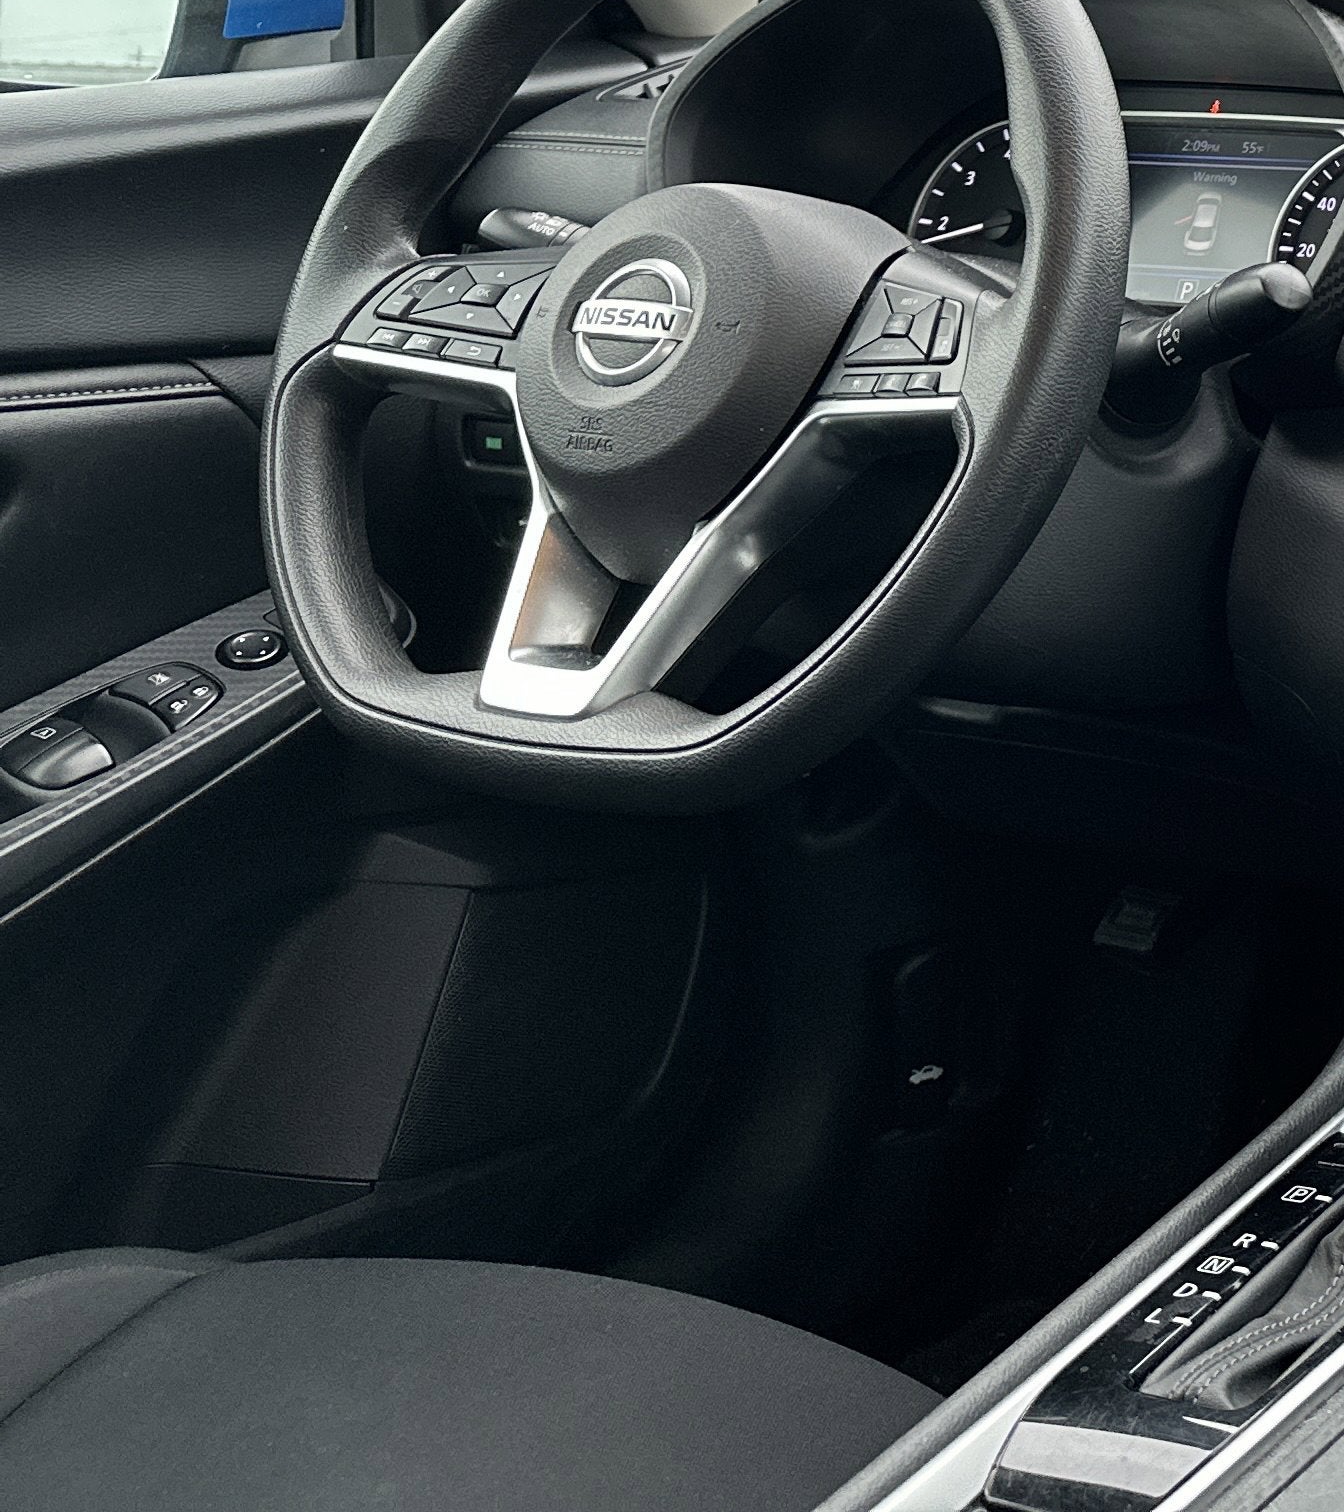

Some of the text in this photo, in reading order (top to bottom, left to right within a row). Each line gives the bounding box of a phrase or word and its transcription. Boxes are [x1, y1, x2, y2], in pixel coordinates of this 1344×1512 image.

[964, 170, 976, 186] 3
[1193, 171, 1238, 186] Warning
[1316, 196, 1337, 213] 40
[527, 221, 554, 236] AUTO
[937, 215, 950, 231] 2
[1296, 243, 1316, 258] 20
[579, 304, 677, 332] NISSAN
[1233, 1234, 1256, 1247] R
[1173, 1283, 1198, 1299] D
[1145, 1308, 1162, 1324] L
